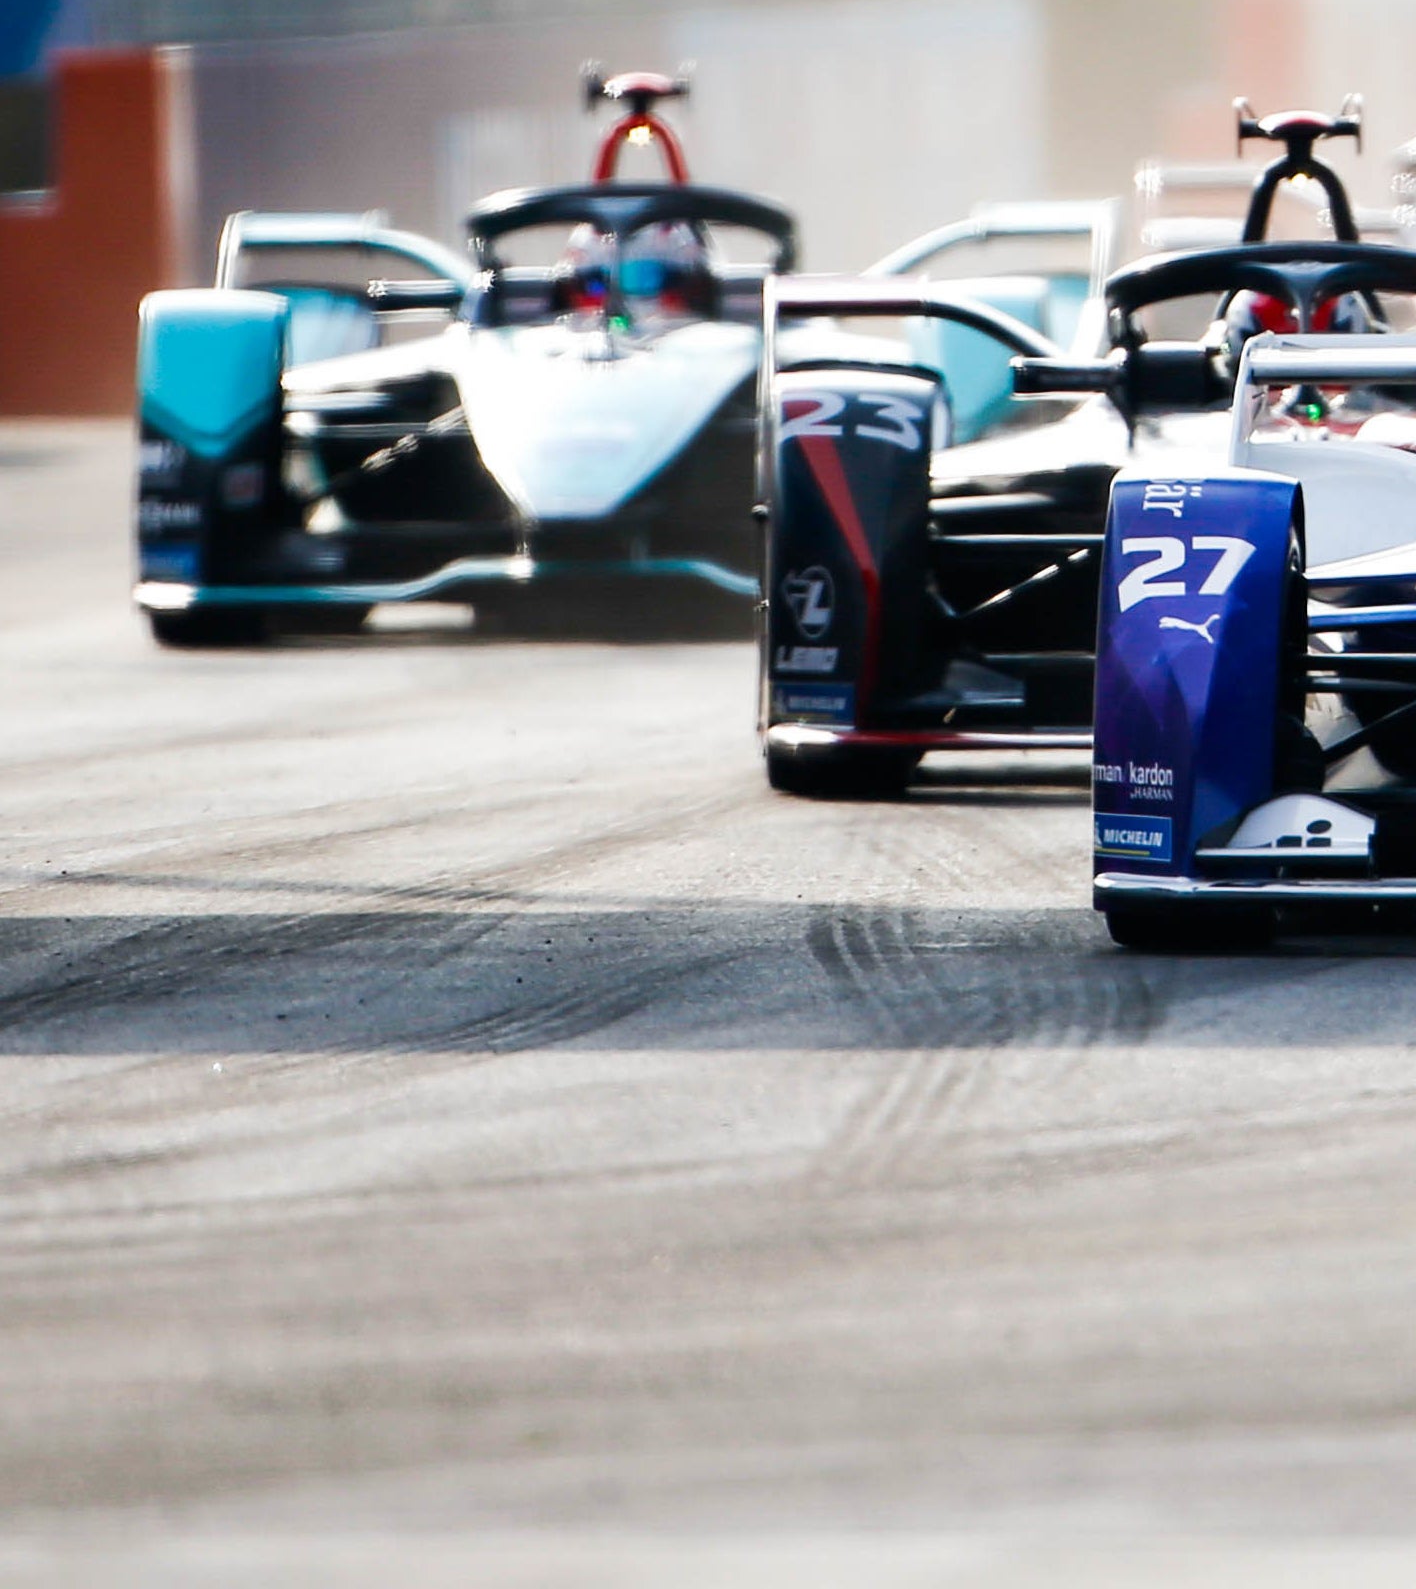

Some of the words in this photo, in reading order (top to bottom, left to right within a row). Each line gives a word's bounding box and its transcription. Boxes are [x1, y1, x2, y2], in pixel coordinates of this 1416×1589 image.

[781, 391, 924, 450] 23
[1143, 480, 1202, 517] är
[1118, 536, 1257, 613] 27
[1128, 761, 1173, 786] kardon
[1103, 828, 1163, 847] MICHELIN
